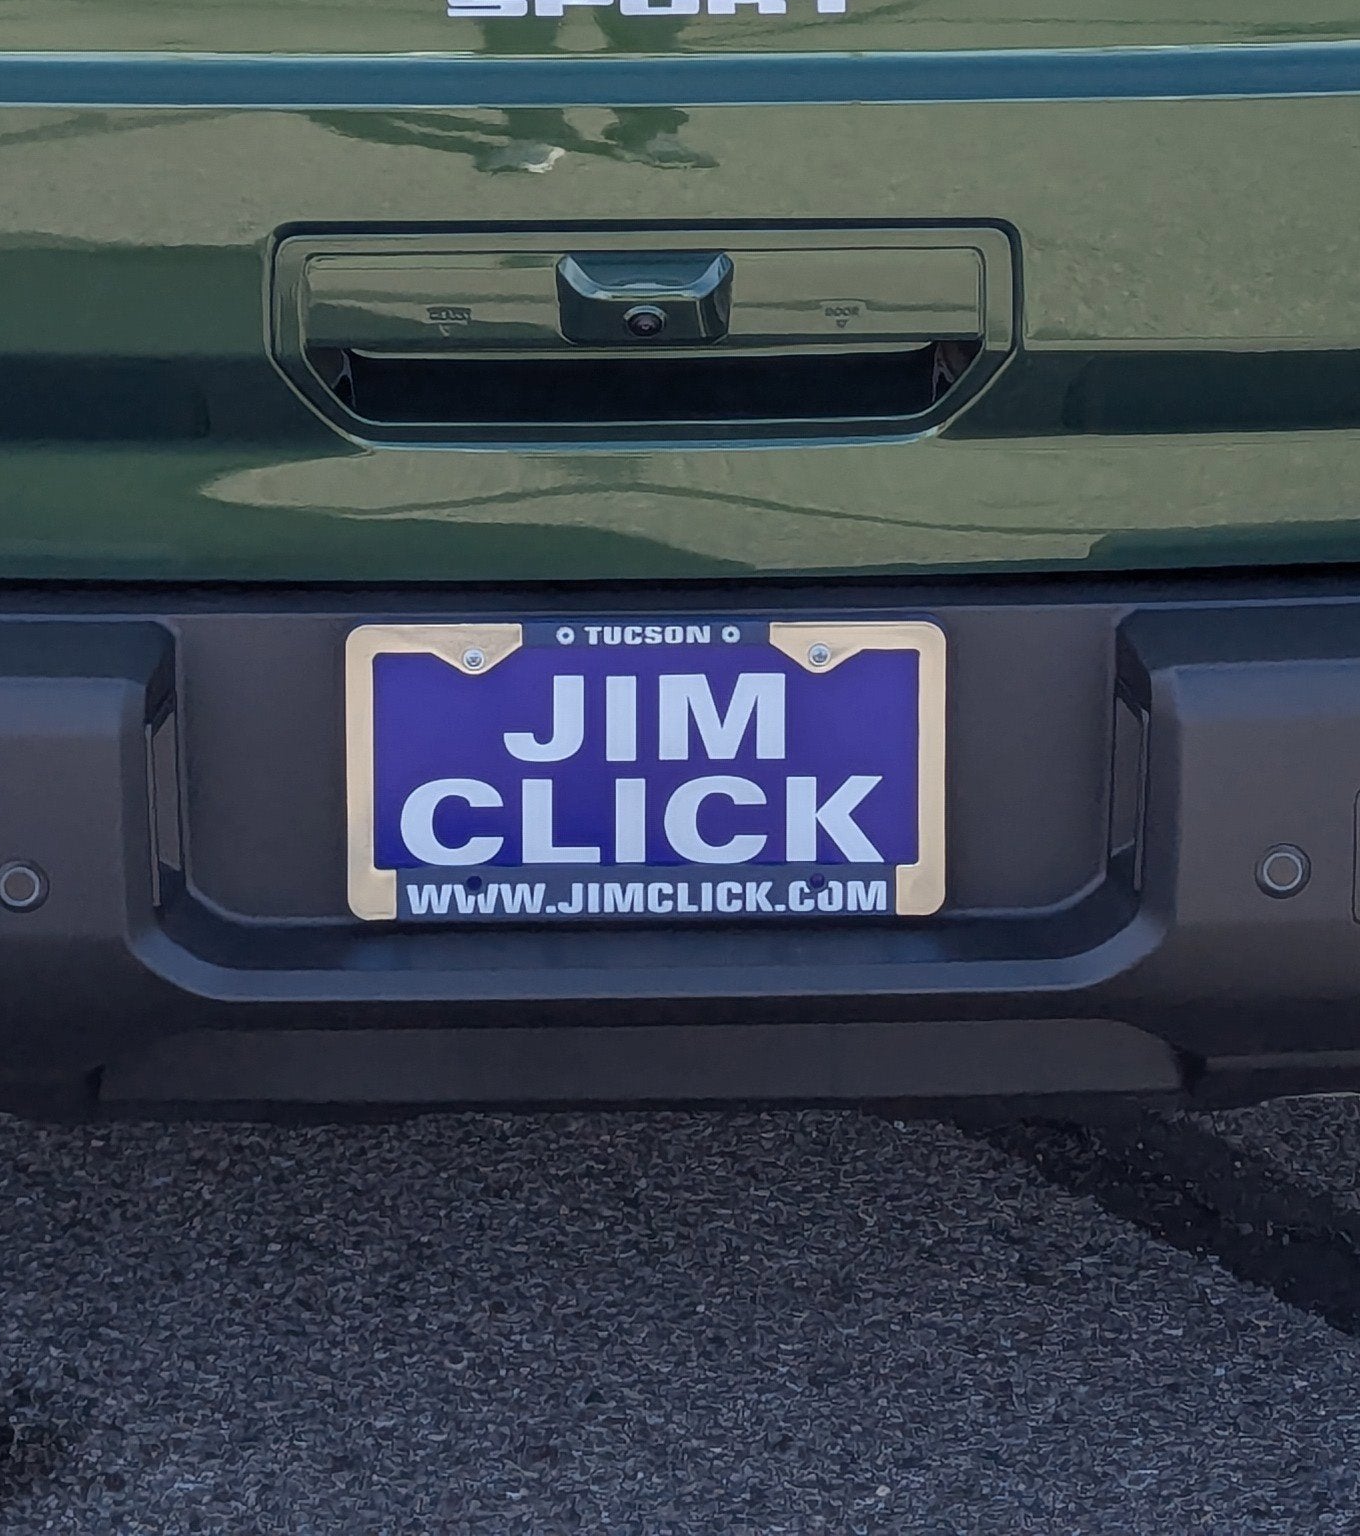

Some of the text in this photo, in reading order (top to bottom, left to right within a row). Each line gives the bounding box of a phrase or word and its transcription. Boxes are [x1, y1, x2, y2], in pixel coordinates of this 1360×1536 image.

[584, 625, 711, 645] TUCSON
[503, 672, 786, 763] JIM
[400, 775, 885, 866] CLICK
[406, 880, 888, 915] WWW.JIMCLICK.COM
